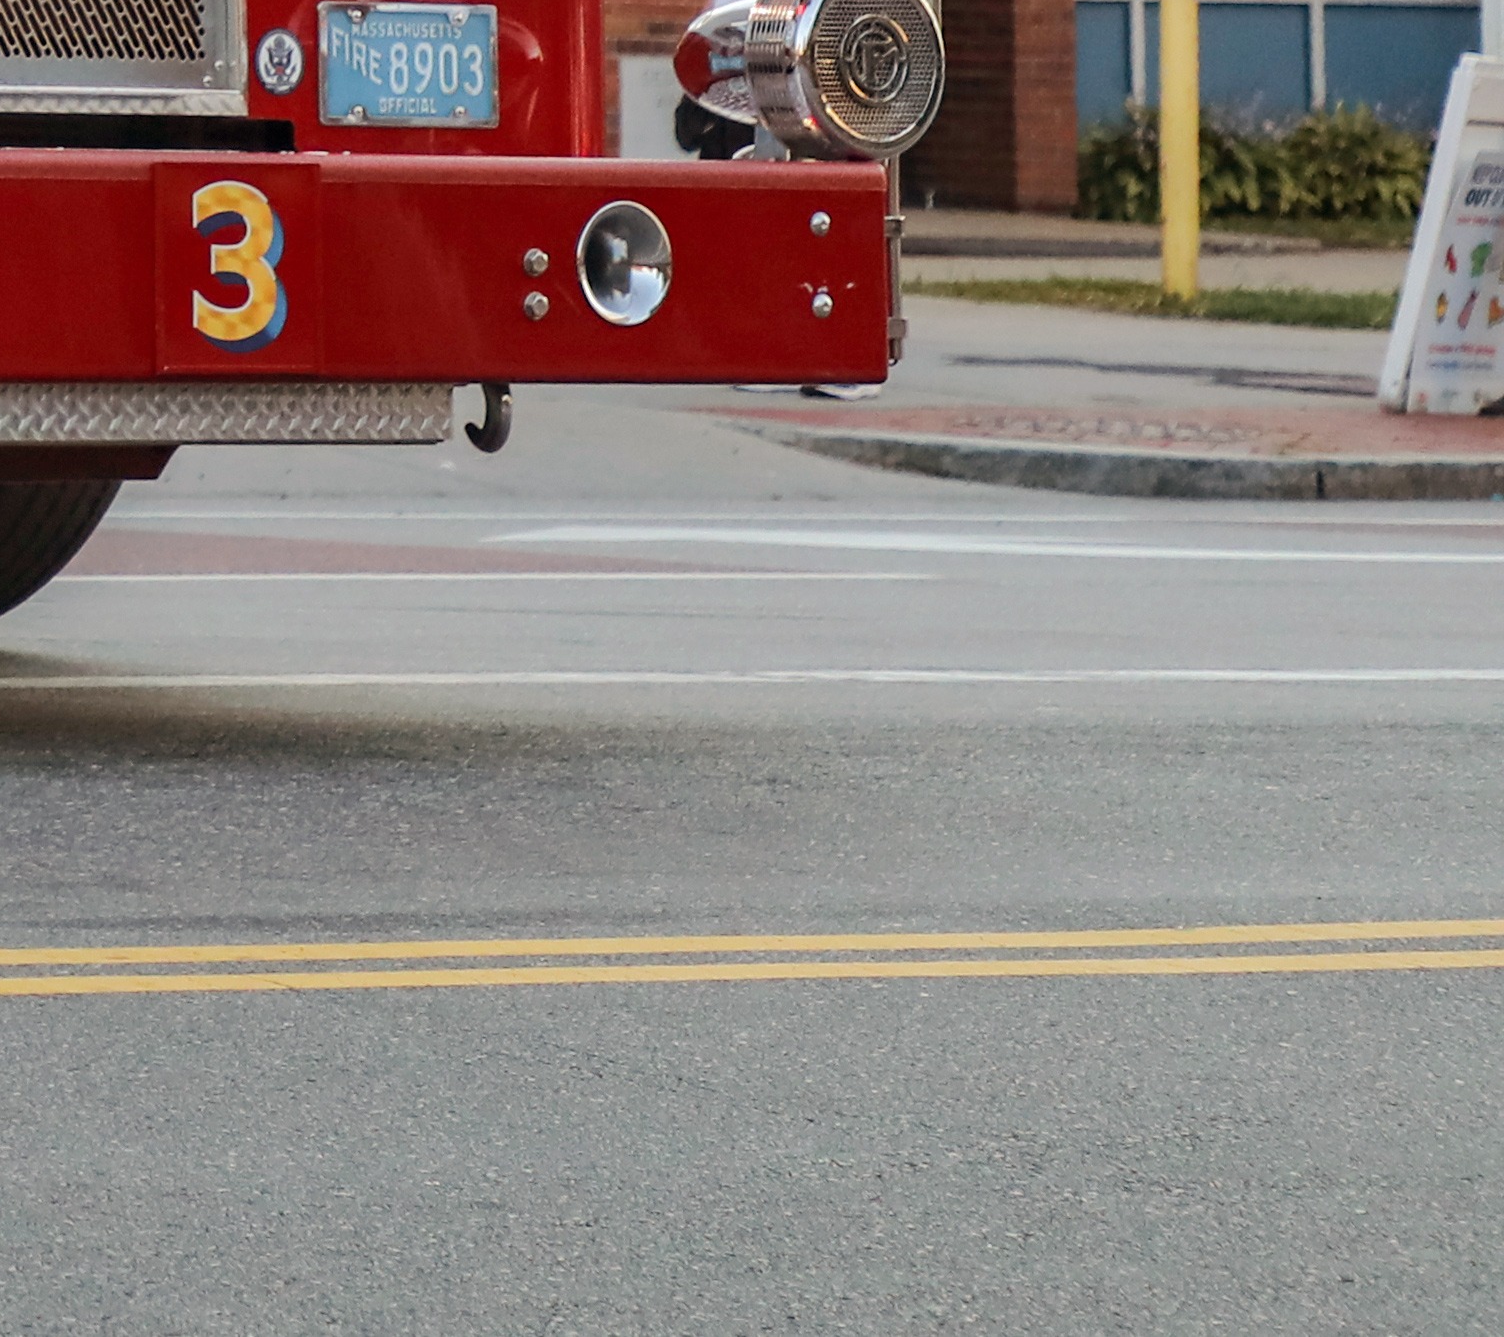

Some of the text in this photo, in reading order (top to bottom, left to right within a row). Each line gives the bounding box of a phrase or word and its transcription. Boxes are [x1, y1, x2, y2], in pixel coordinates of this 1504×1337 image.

[351, 20, 463, 40] MASSACHUSETTS
[330, 26, 484, 96] FIRE 8903
[378, 97, 438, 114] OFFICIAL
[192, 180, 288, 353] 3
